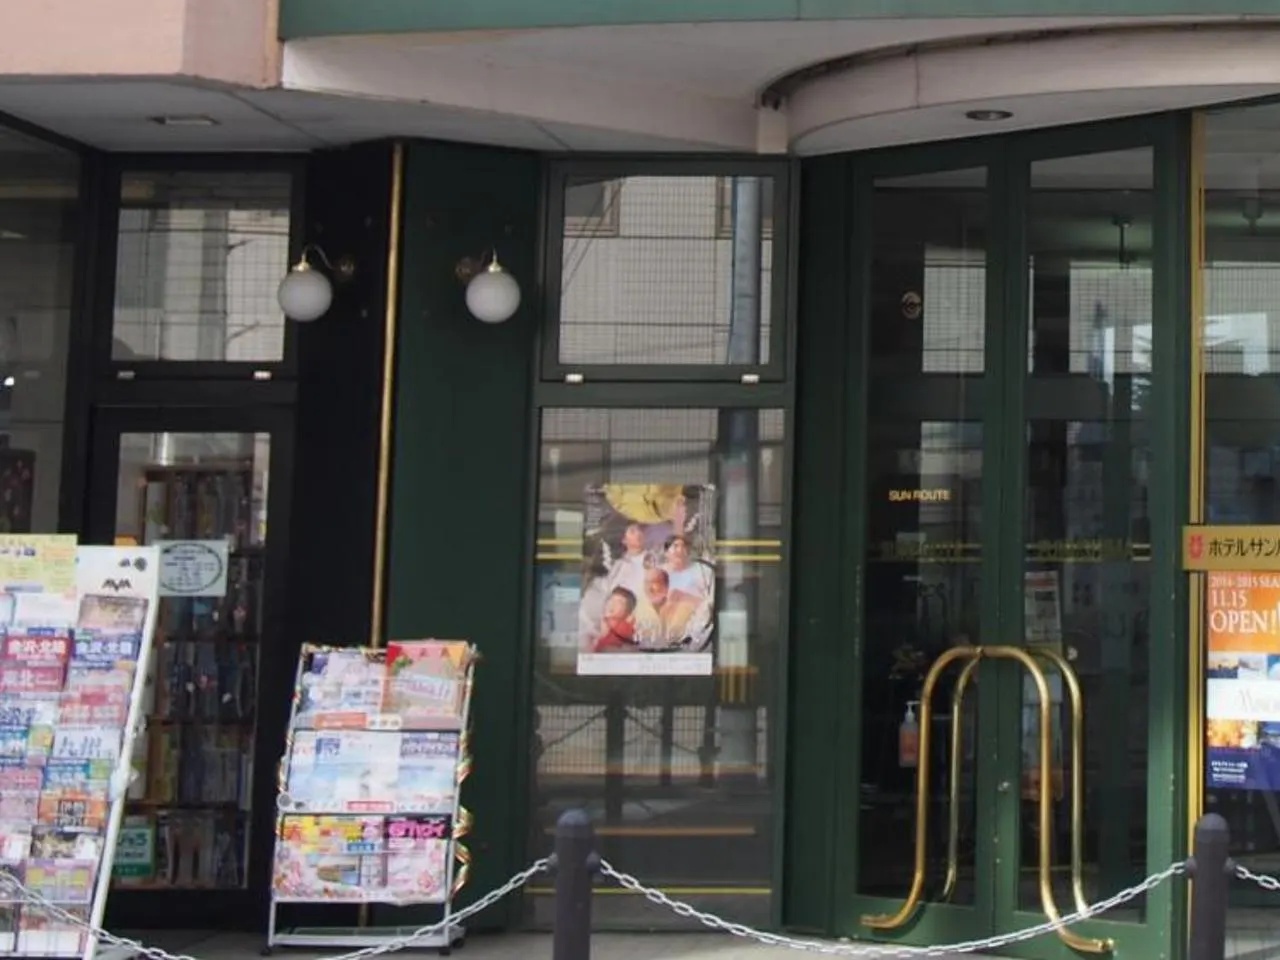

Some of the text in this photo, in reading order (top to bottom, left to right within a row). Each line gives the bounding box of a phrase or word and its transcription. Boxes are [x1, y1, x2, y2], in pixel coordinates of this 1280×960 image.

[889, 489, 950, 501] SUN ROUTE
[1211, 589, 1247, 607] 11.15
[1210, 609, 1277, 635] OPEN!
